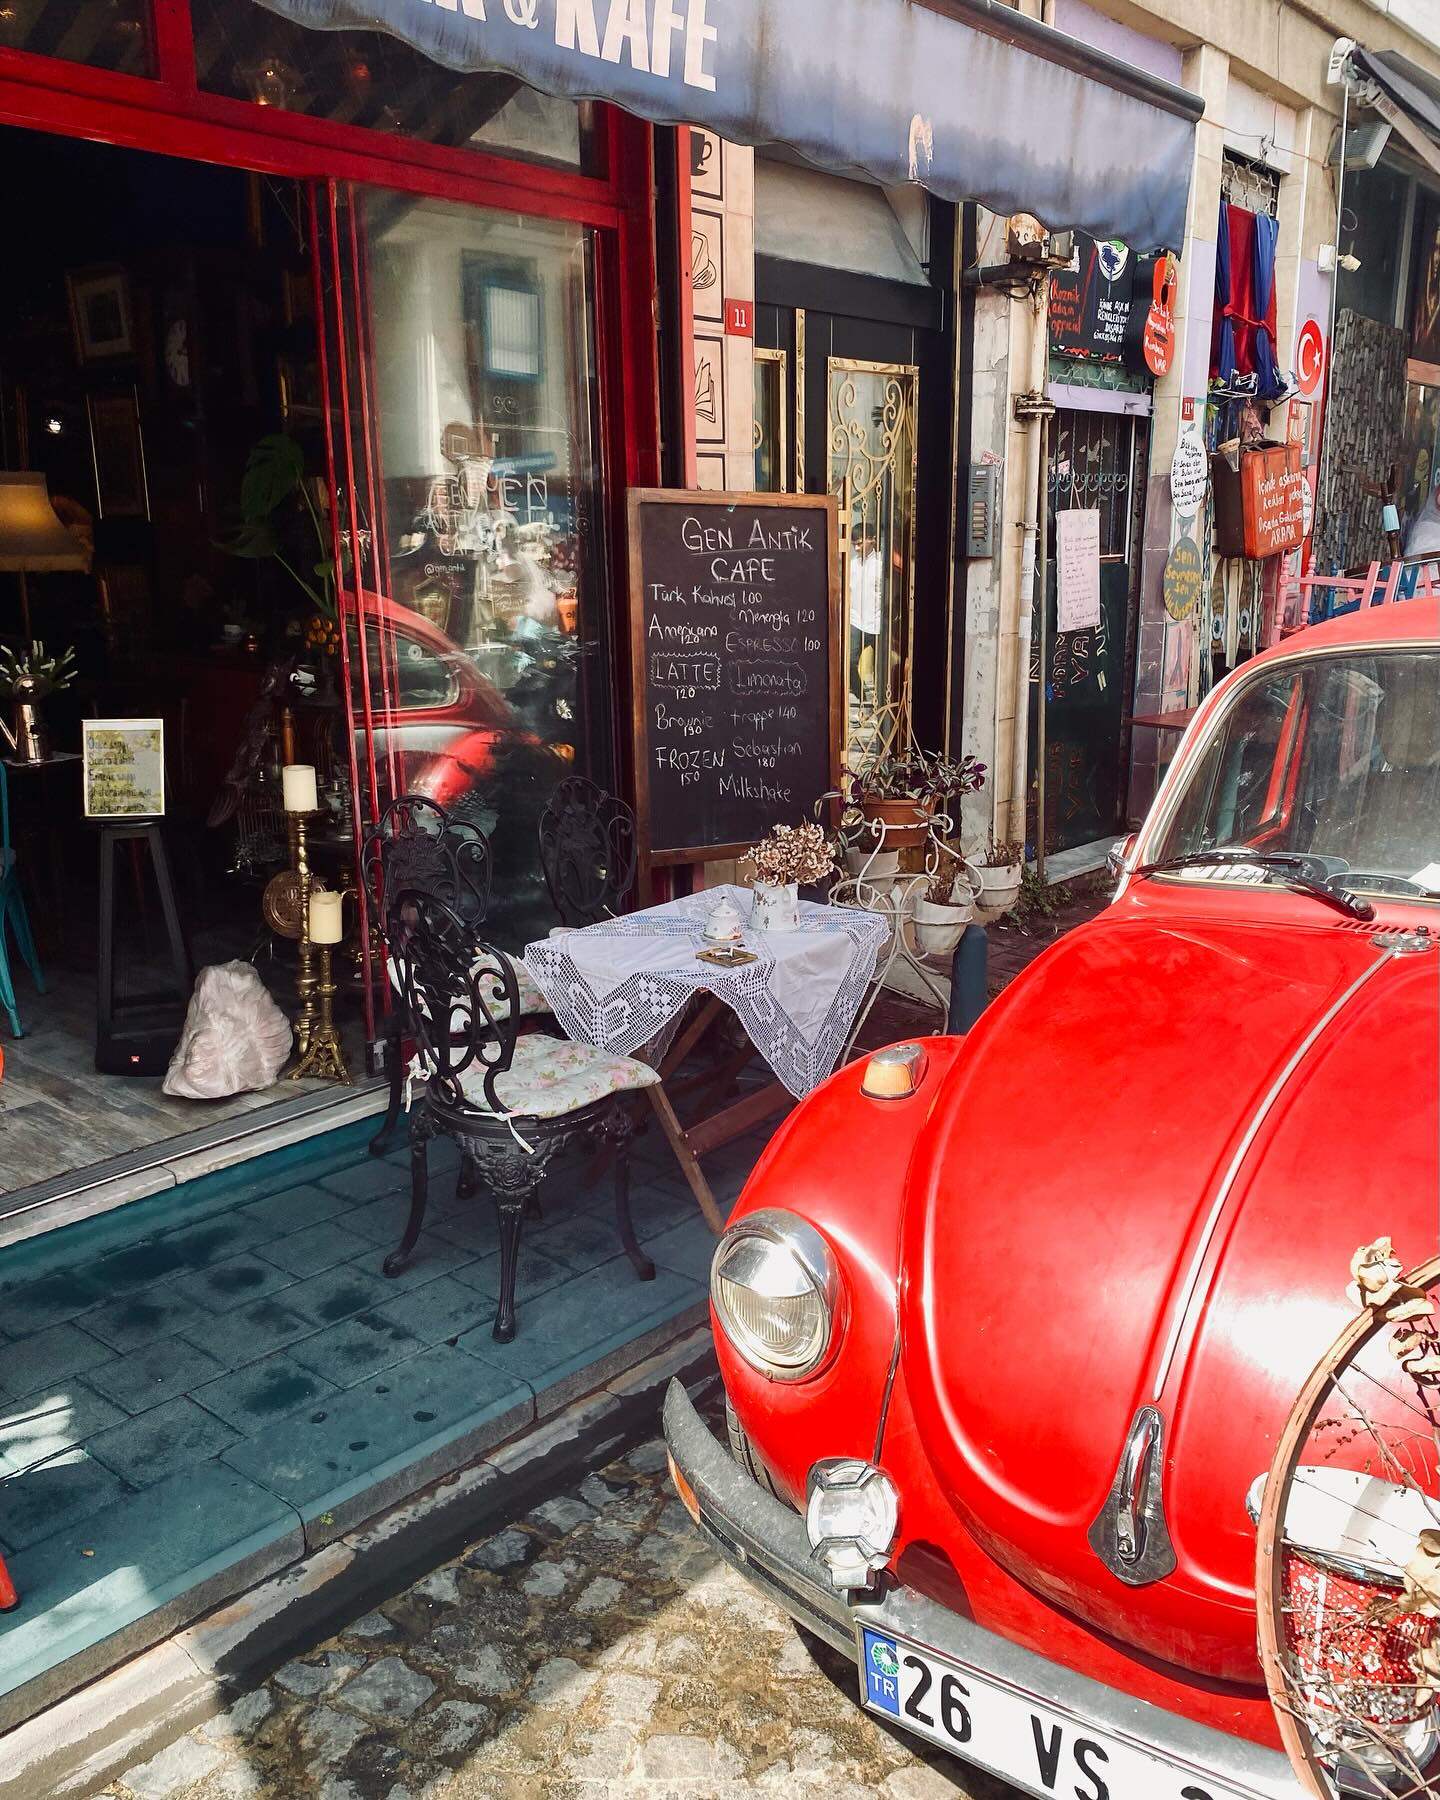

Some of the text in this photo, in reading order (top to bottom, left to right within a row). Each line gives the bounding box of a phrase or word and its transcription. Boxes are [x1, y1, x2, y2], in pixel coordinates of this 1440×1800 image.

[555, 0, 718, 92] KAFE
[734, 308, 747, 328] 11
[681, 517, 734, 553] GEN
[711, 558, 776, 582] CAFE
[648, 583, 687, 606] Türk
[742, 590, 763, 605] 100
[797, 609, 815, 623] 120
[804, 636, 821, 652] 100
[656, 660, 715, 682] LATTE
[736, 665, 801, 690] Limonata
[676, 687, 696, 700] 120
[655, 703, 714, 730] Brownie
[779, 705, 797, 719] 140
[655, 747, 725, 770] FROZEN
[732, 736, 802, 758] Sebastian
[758, 756, 776, 768] 180
[681, 770, 700, 786] 150
[719, 773, 791, 802] Milkshake
[870, 1672, 896, 1700] TR
[903, 1655, 1110, 1800] 26 VS
